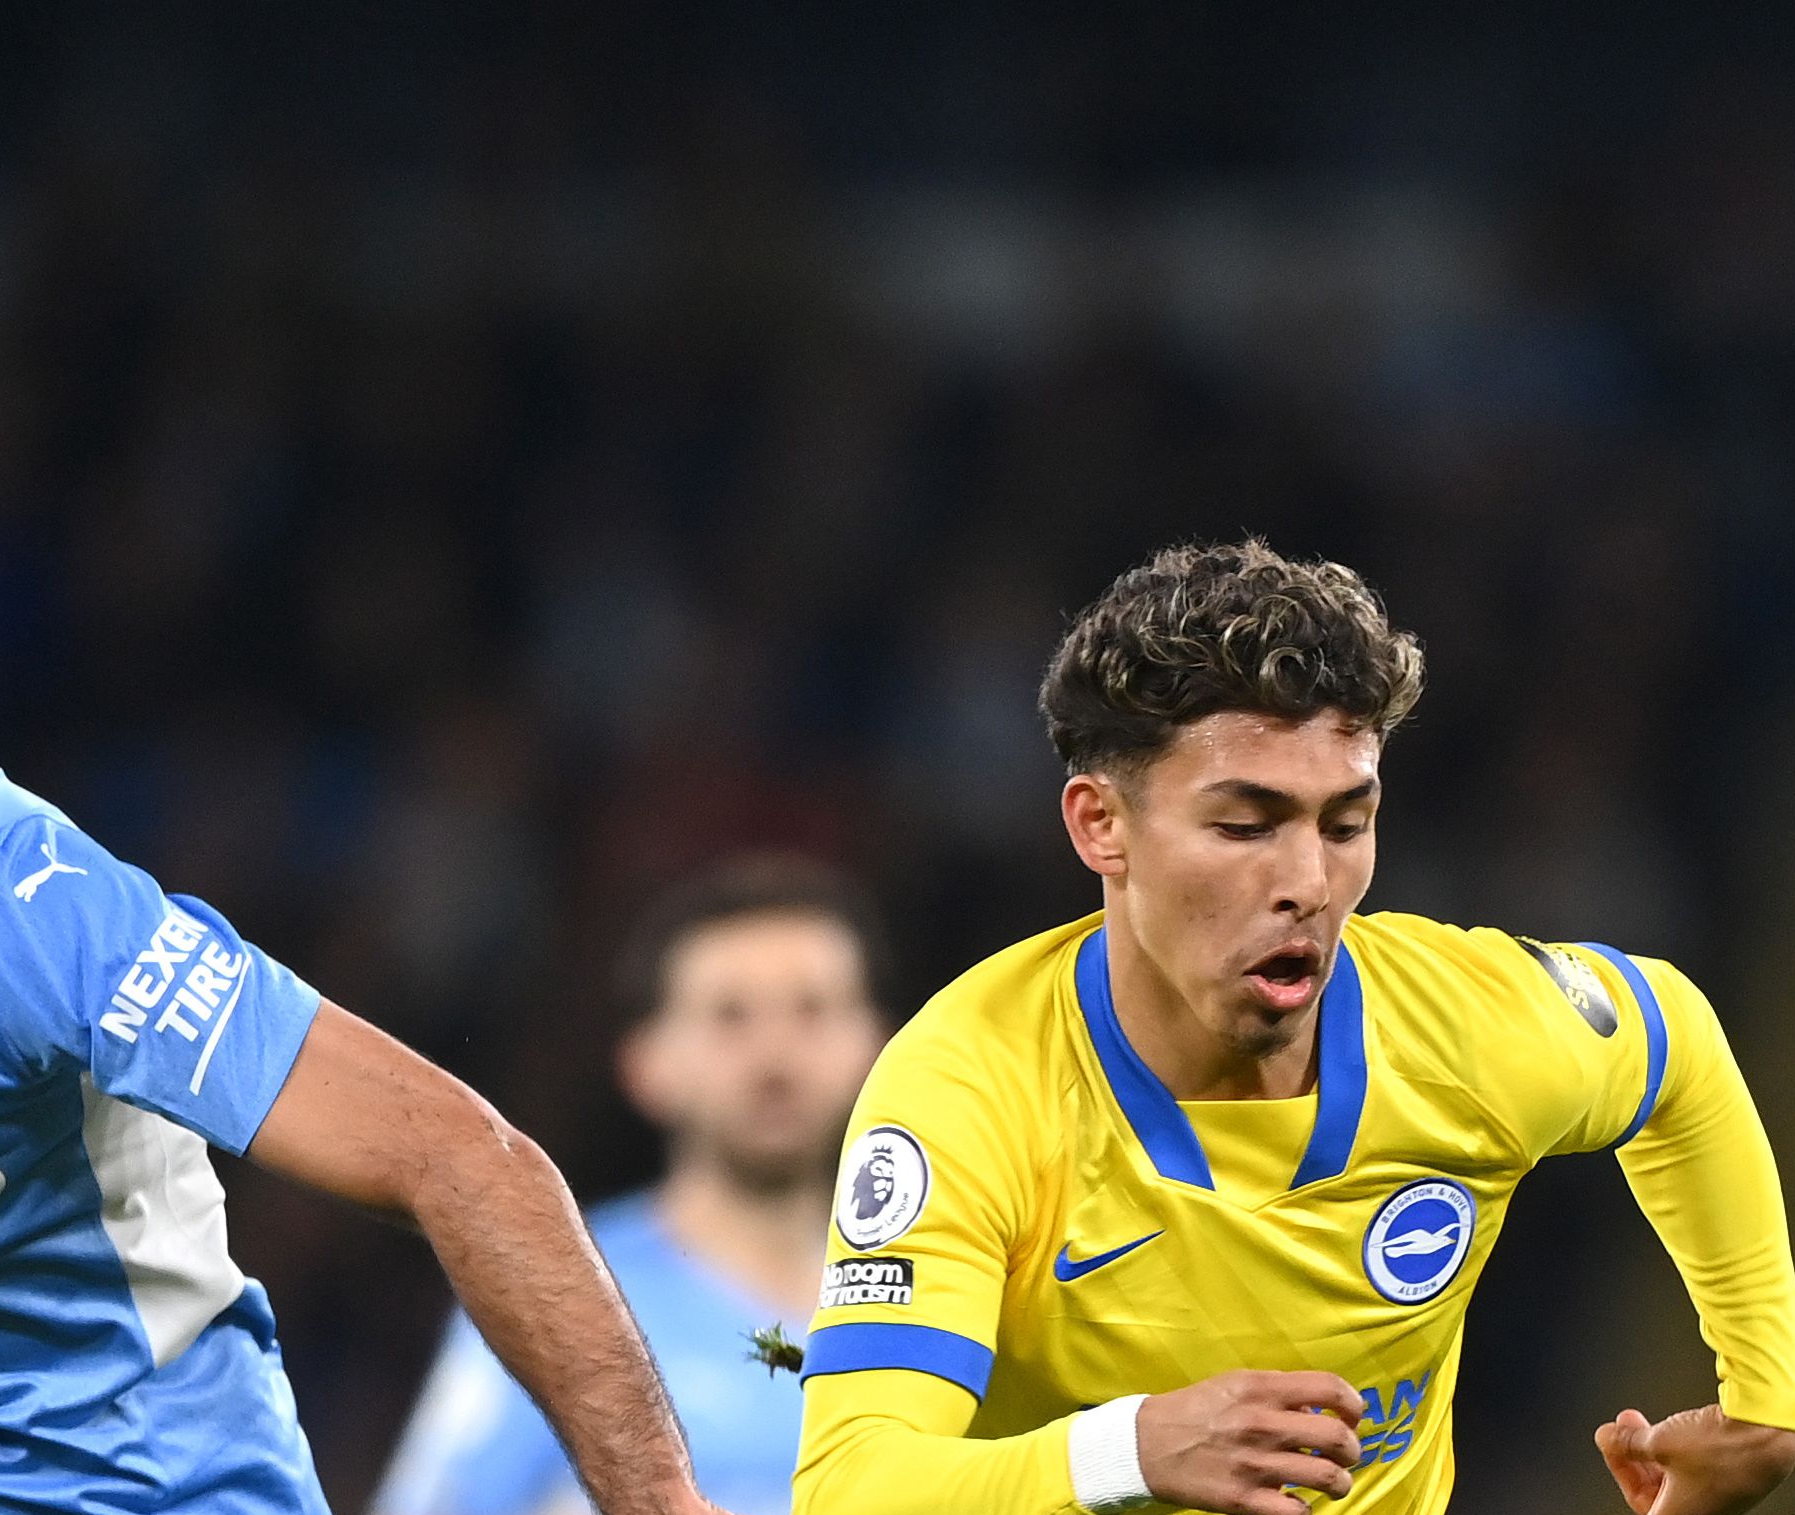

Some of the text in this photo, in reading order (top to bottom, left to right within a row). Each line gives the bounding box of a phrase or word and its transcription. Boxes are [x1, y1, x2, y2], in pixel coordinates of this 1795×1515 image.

[98, 910, 209, 1044] NEXEN
[154, 940, 242, 1042] TIRE
[1380, 1186, 1433, 1224] BRIGHTON
[844, 1262, 904, 1286] room
[1397, 1281, 1437, 1296] ALBION
[838, 1284, 912, 1305] racism
